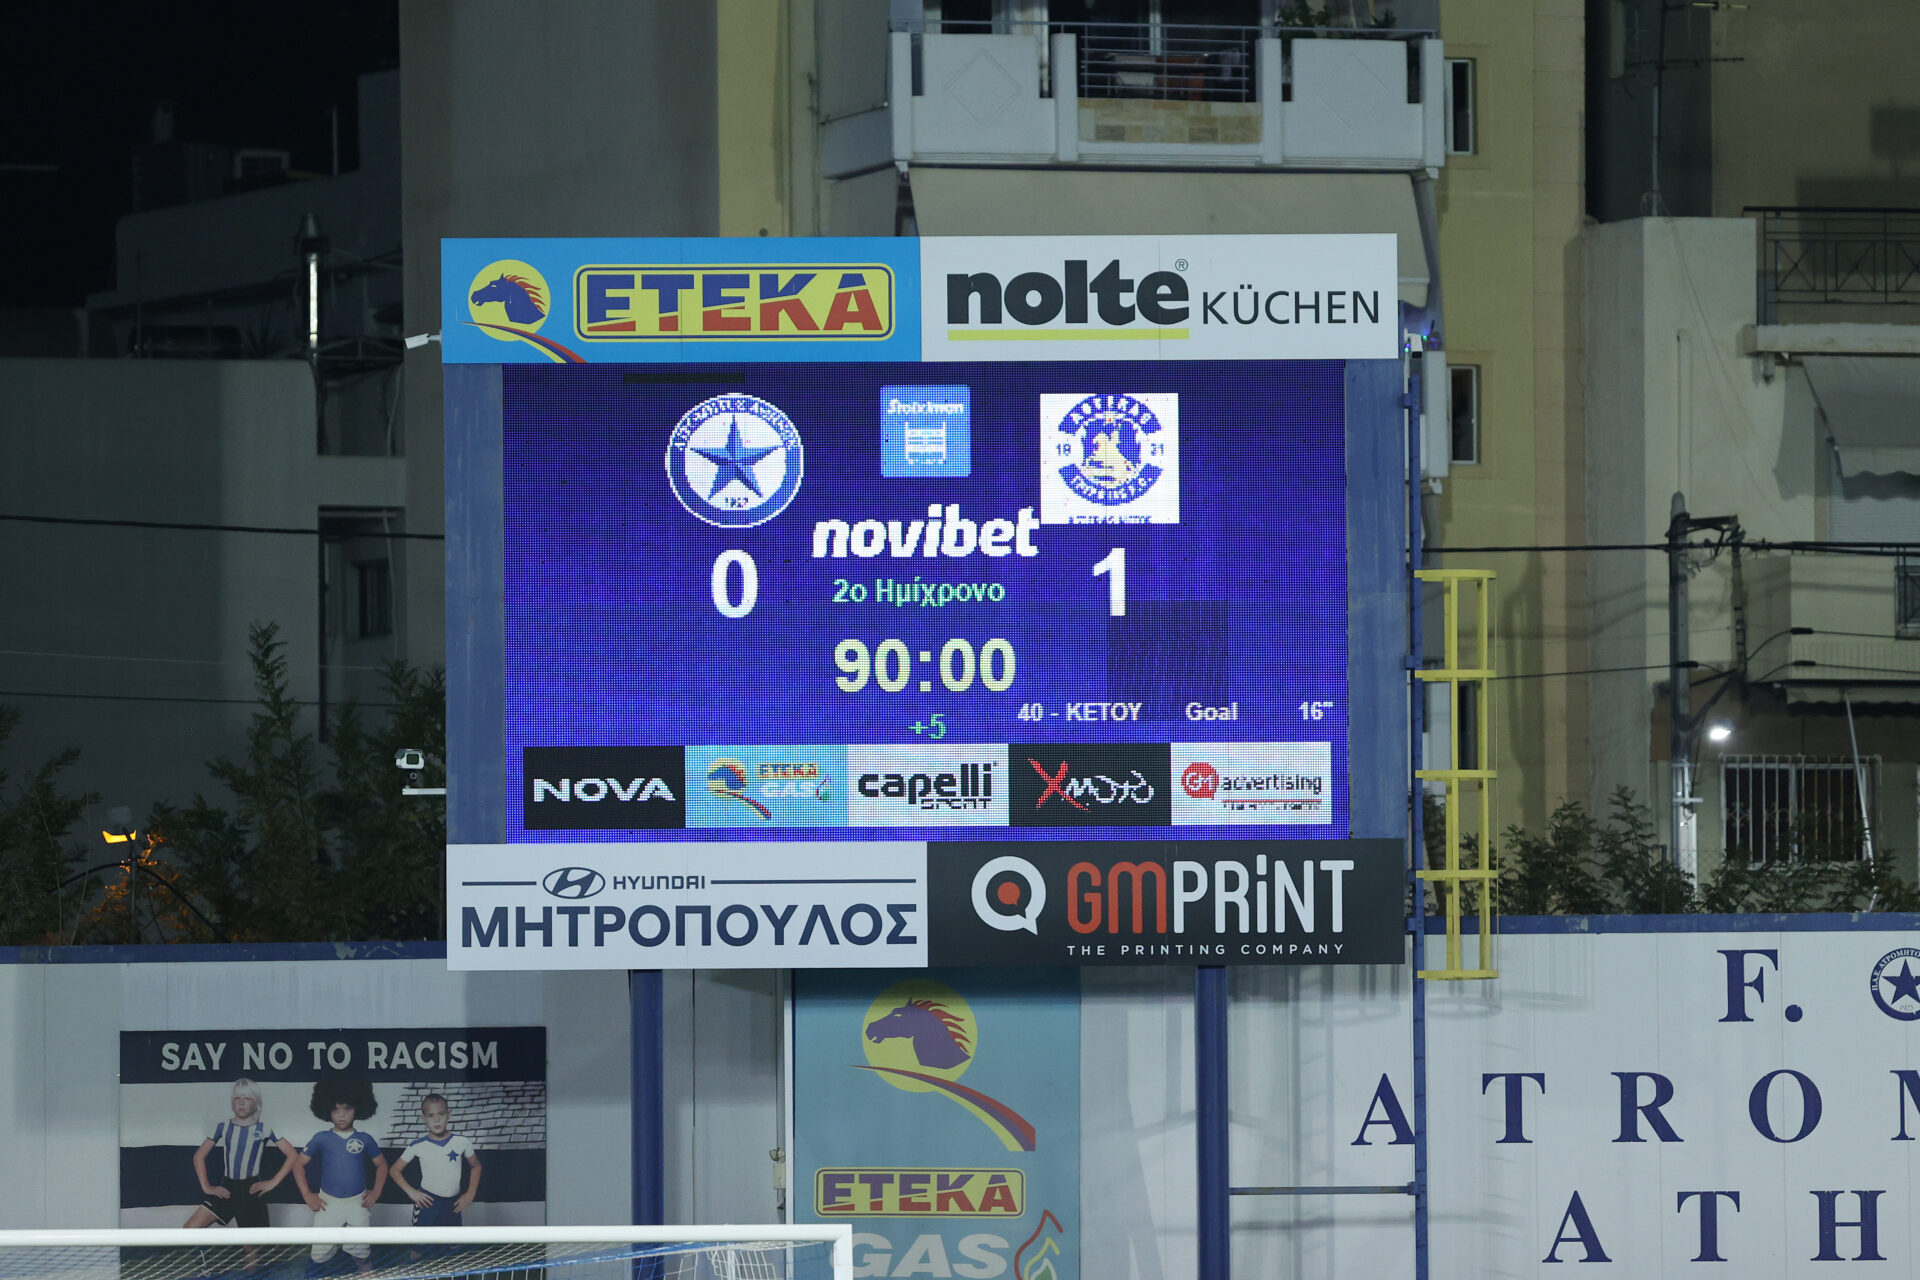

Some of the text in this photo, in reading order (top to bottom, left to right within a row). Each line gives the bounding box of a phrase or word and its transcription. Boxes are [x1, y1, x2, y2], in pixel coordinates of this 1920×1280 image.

[586, 273, 883, 332] ETEKA
[946, 259, 1379, 326] nolte KÜCHEN
[812, 503, 1041, 558] novibet
[711, 549, 759, 618] 0
[874, 577, 1006, 607] Ημίχρονο
[1092, 547, 1127, 616] 1
[833, 638, 1017, 693] 90:00
[907, 713, 948, 740] +5
[1017, 702, 1044, 721] 40
[1185, 702, 1239, 721] Goal
[532, 777, 677, 802] NOVA
[857, 763, 993, 805] capelli
[612, 875, 706, 890] HYUNDAI
[461, 903, 918, 948] ΜΗΤΡΟΠΟΥΛΟΣ
[1067, 943, 1344, 956] THE PRINTING COMPANY
[161, 1041, 499, 1072] SAY NO TO RACISM
[822, 1174, 1018, 1212] ETEKA
[851, 1232, 1010, 1279] GAS
